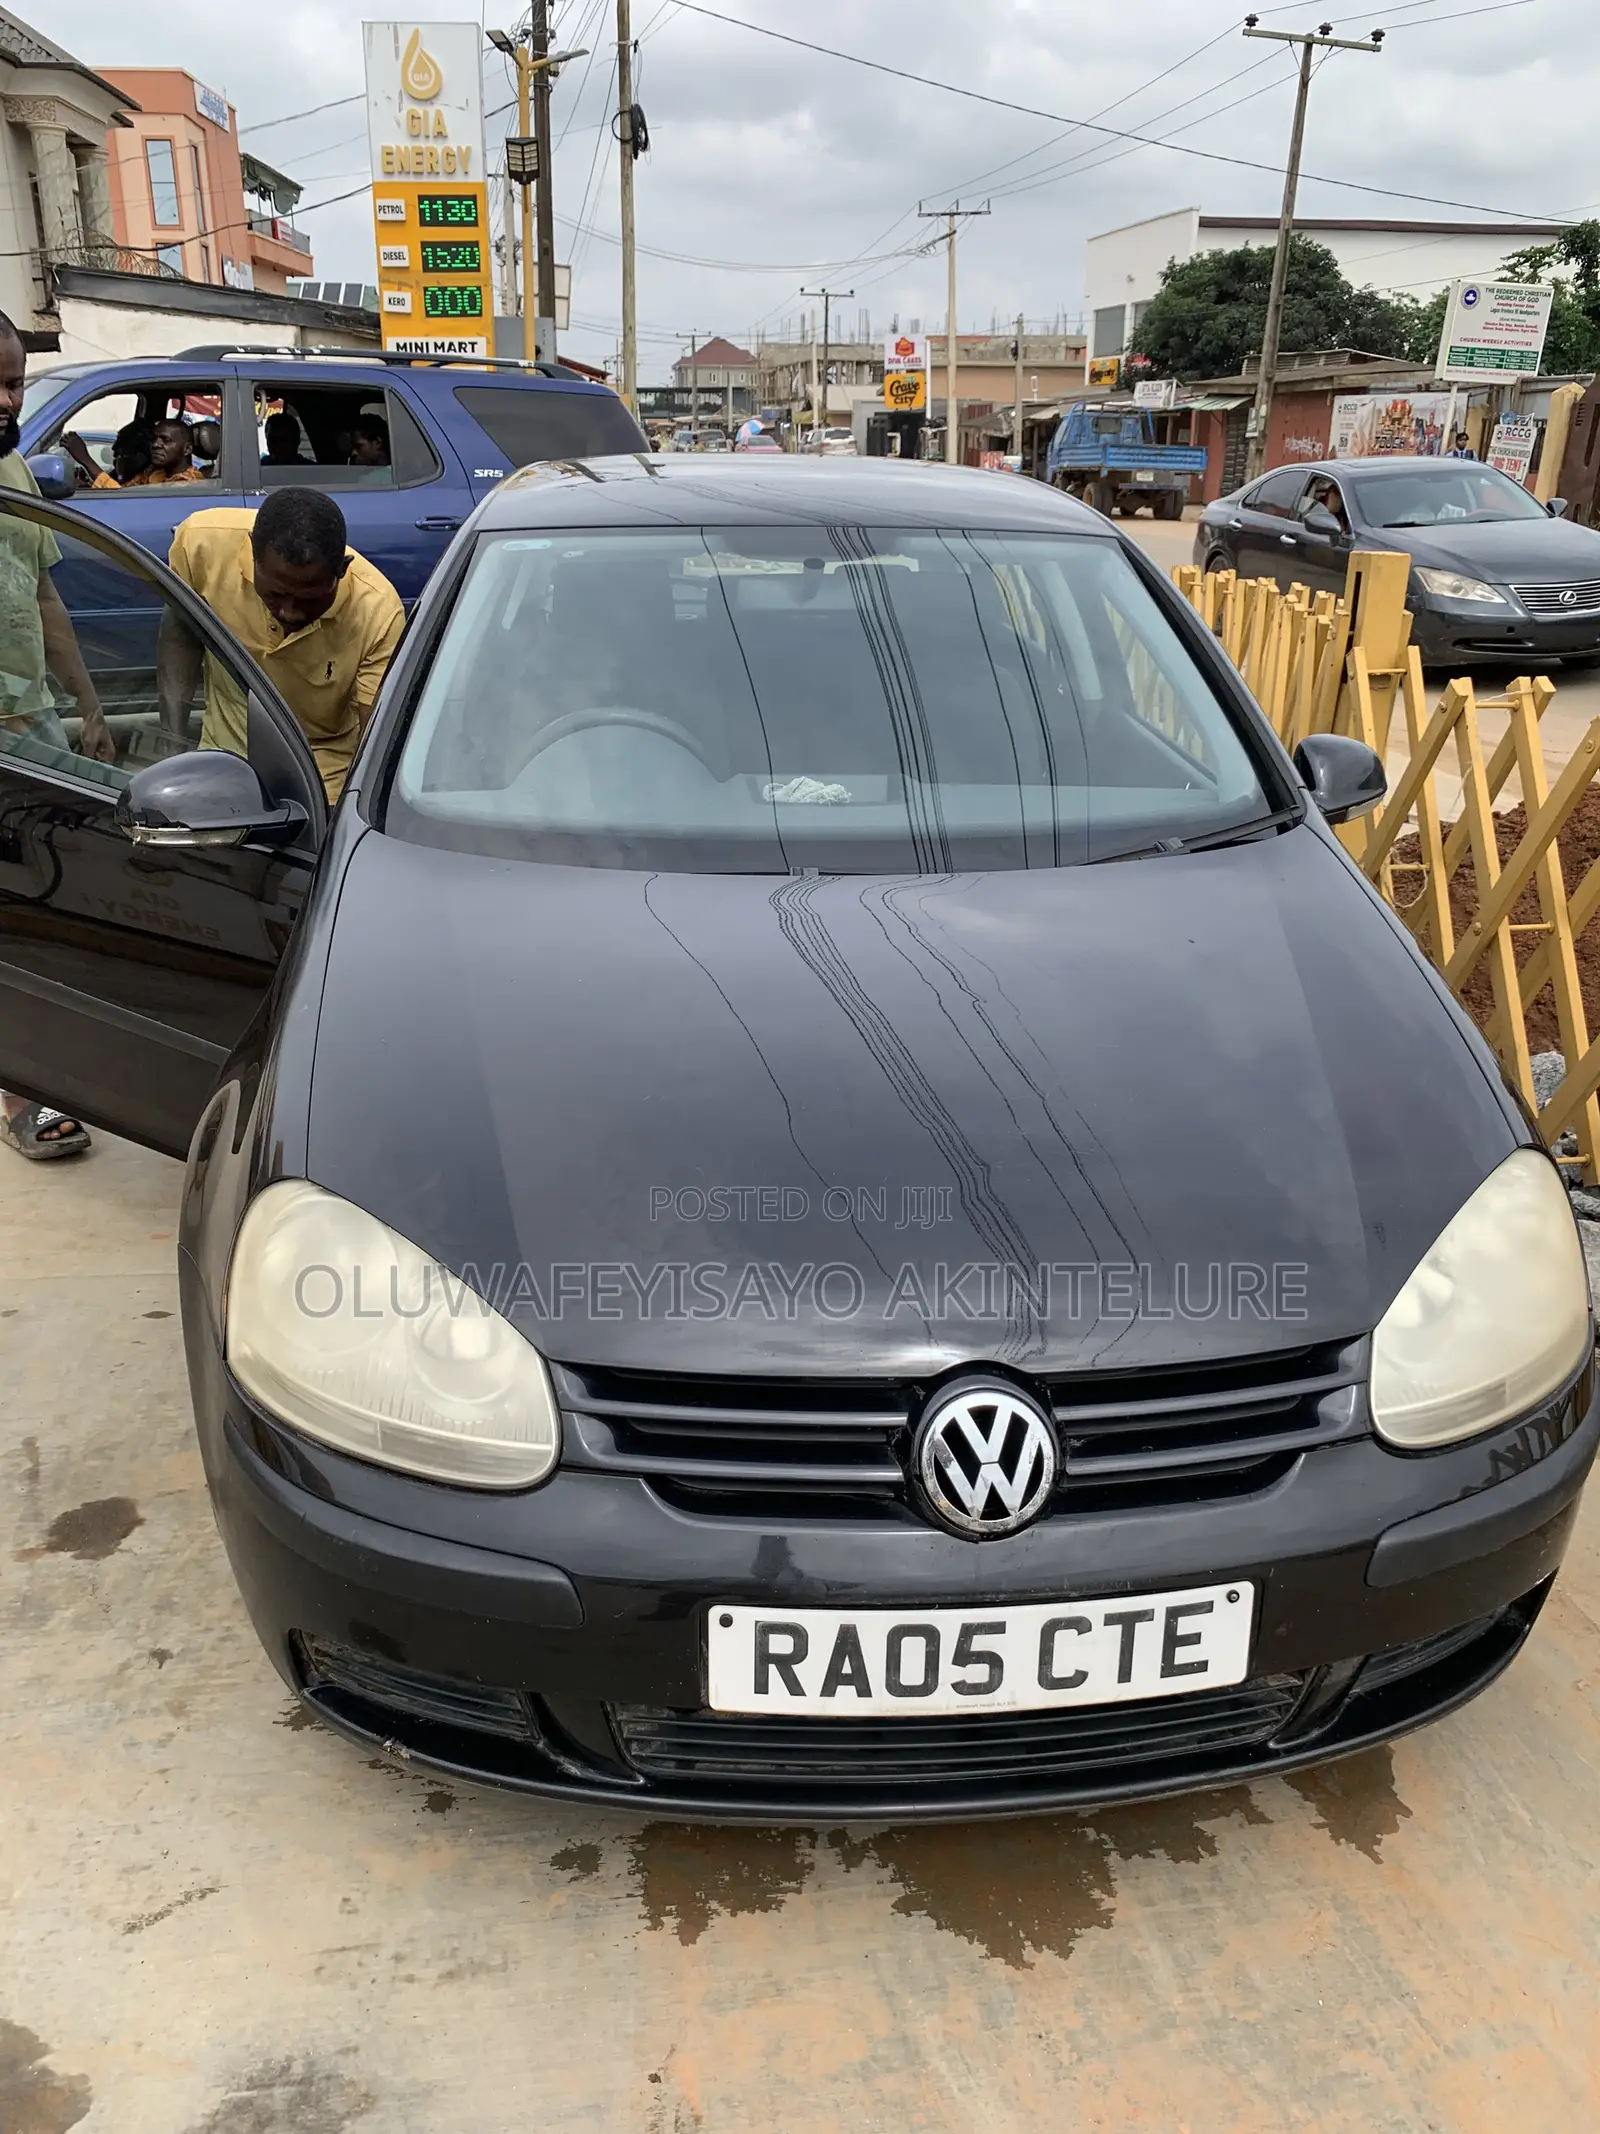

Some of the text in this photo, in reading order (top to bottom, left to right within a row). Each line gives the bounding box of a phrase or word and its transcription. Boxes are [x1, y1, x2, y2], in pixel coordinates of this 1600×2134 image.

[406, 108, 448, 138] GIA
[381, 145, 472, 174] ENERGY
[378, 205, 404, 214] PETROL
[419, 200, 476, 221] 1130
[382, 251, 406, 260] DIESEL
[422, 247, 480, 268] 1520
[388, 296, 406, 306] KERO
[425, 287, 482, 315] 000
[1496, 288, 1524, 296] REDEEMED
[1524, 290, 1551, 298] CHRISTIAN
[396, 341, 478, 353] MINI MART
[889, 380, 920, 397] Crave
[1505, 427, 1532, 438] RCCG
[753, 1600, 1215, 1699] RA05 CTE
